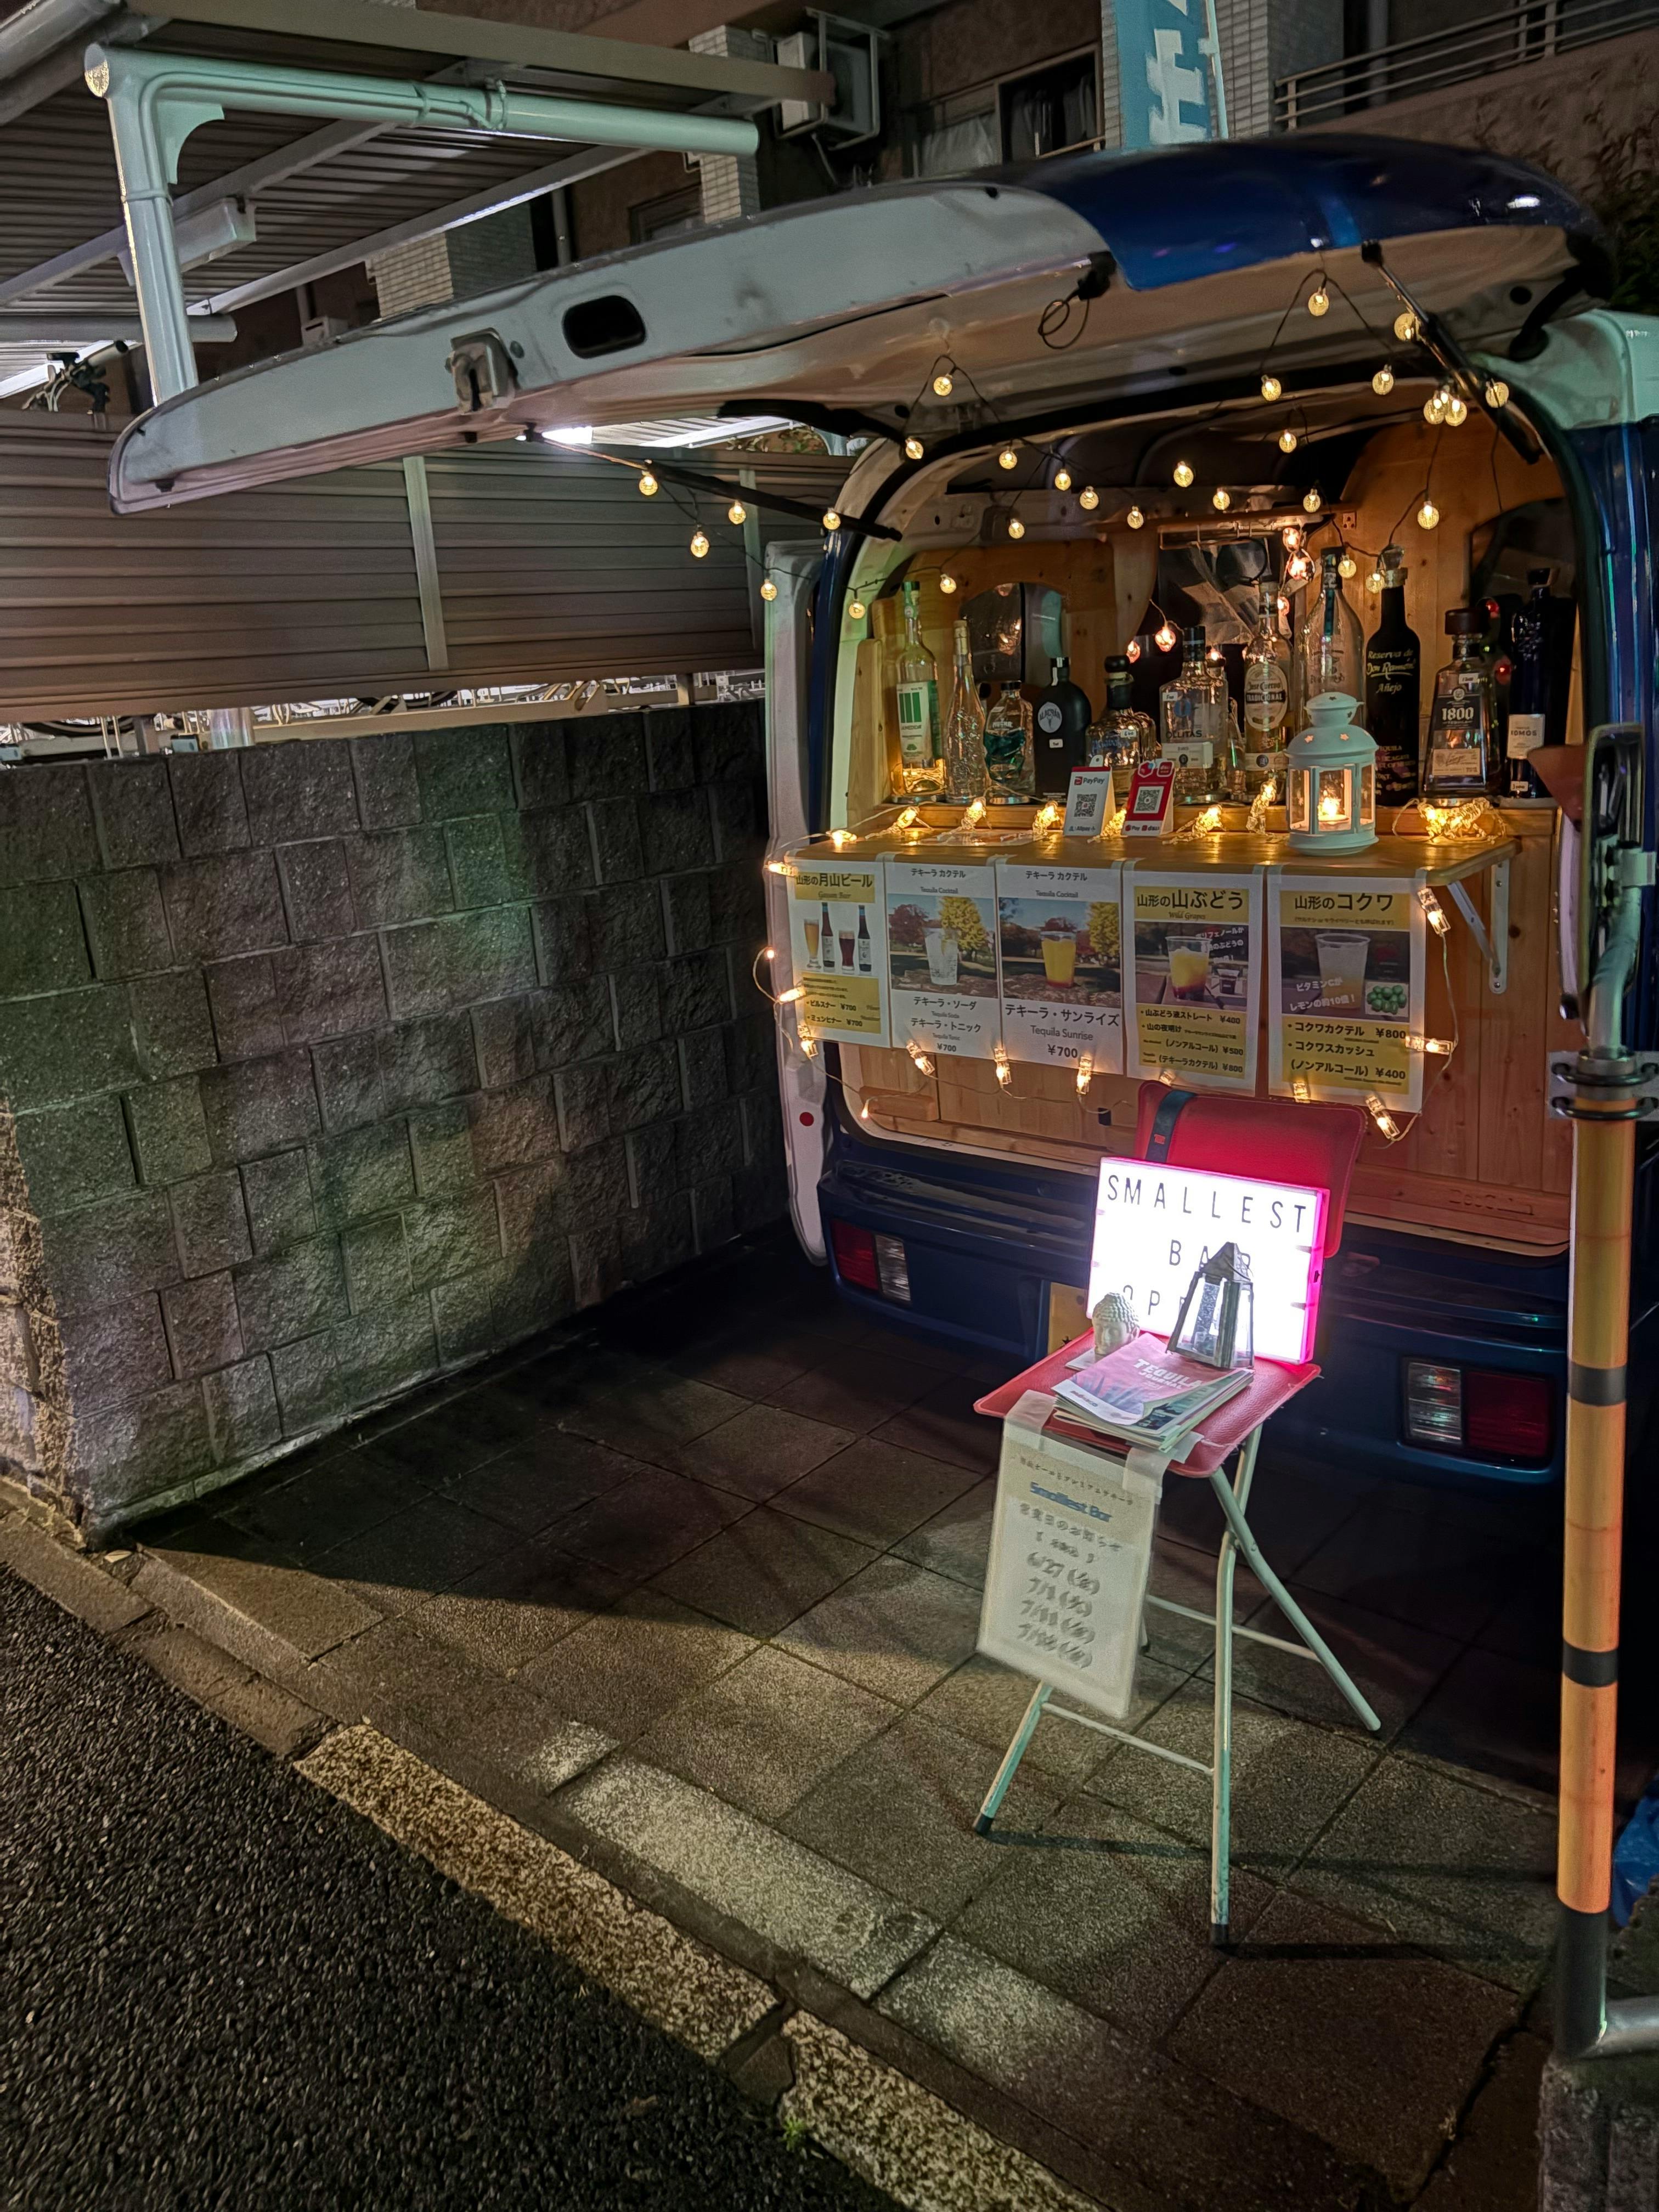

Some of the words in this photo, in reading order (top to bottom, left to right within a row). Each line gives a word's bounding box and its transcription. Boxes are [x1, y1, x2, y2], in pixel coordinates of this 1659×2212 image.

[1442, 707, 1474, 721] 1800
[1083, 777, 1105, 786] PayPay
[911, 868, 938, 878] テキーラ
[939, 870, 966, 878] カクテル
[1025, 871, 1055, 880] テキーラ
[1057, 872, 1087, 882] カクテル
[1137, 889, 1243, 910] 山形の山ぶどう
[1295, 893, 1393, 911] 山形のコクワ
[913, 996, 977, 1011] テキーラ・ソーダ
[1005, 1004, 1120, 1026] テキーラ・サンライズ
[1220, 1015, 1240, 1024] ¥400
[911, 1018, 981, 1032] テキーラ・トニック
[1030, 1025, 1060, 1037] Tequila
[1062, 1029, 1093, 1041] Sunrise
[1375, 1028, 1406, 1039] ¥800
[937, 1043, 956, 1052] ¥700
[1047, 1044, 1078, 1058] ¥700
[1223, 1046, 1244, 1056] ¥500
[1375, 1067, 1406, 1080] ¥400
[1107, 1174, 1307, 1233] SMALLEST
[1133, 1358, 1203, 1388] TEQUILA
[1138, 1371, 1182, 1389] JOURNAL
